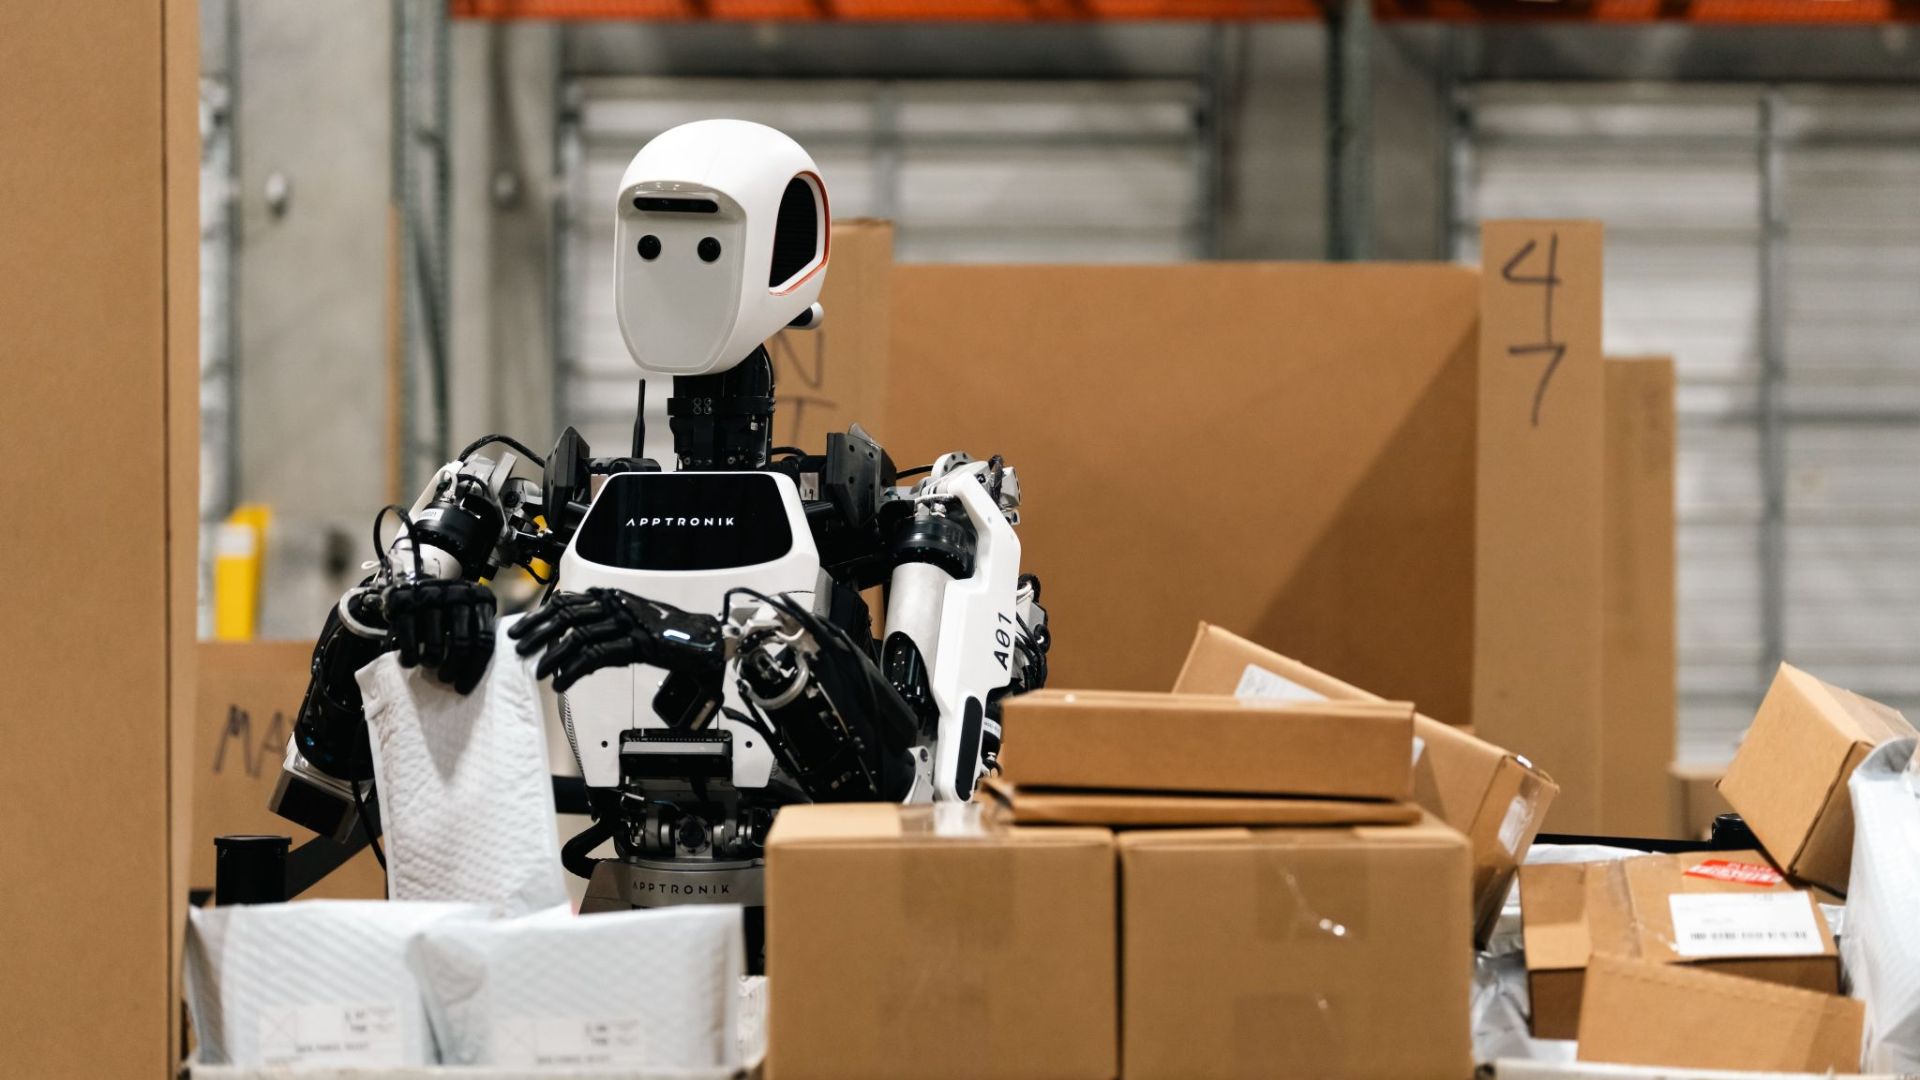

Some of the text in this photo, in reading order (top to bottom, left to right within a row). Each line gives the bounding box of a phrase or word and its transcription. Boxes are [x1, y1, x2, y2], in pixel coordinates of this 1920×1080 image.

[625, 517, 734, 527] APPTRONIK
[993, 612, 1012, 671] A01
[632, 881, 730, 895] APPTRONIK
